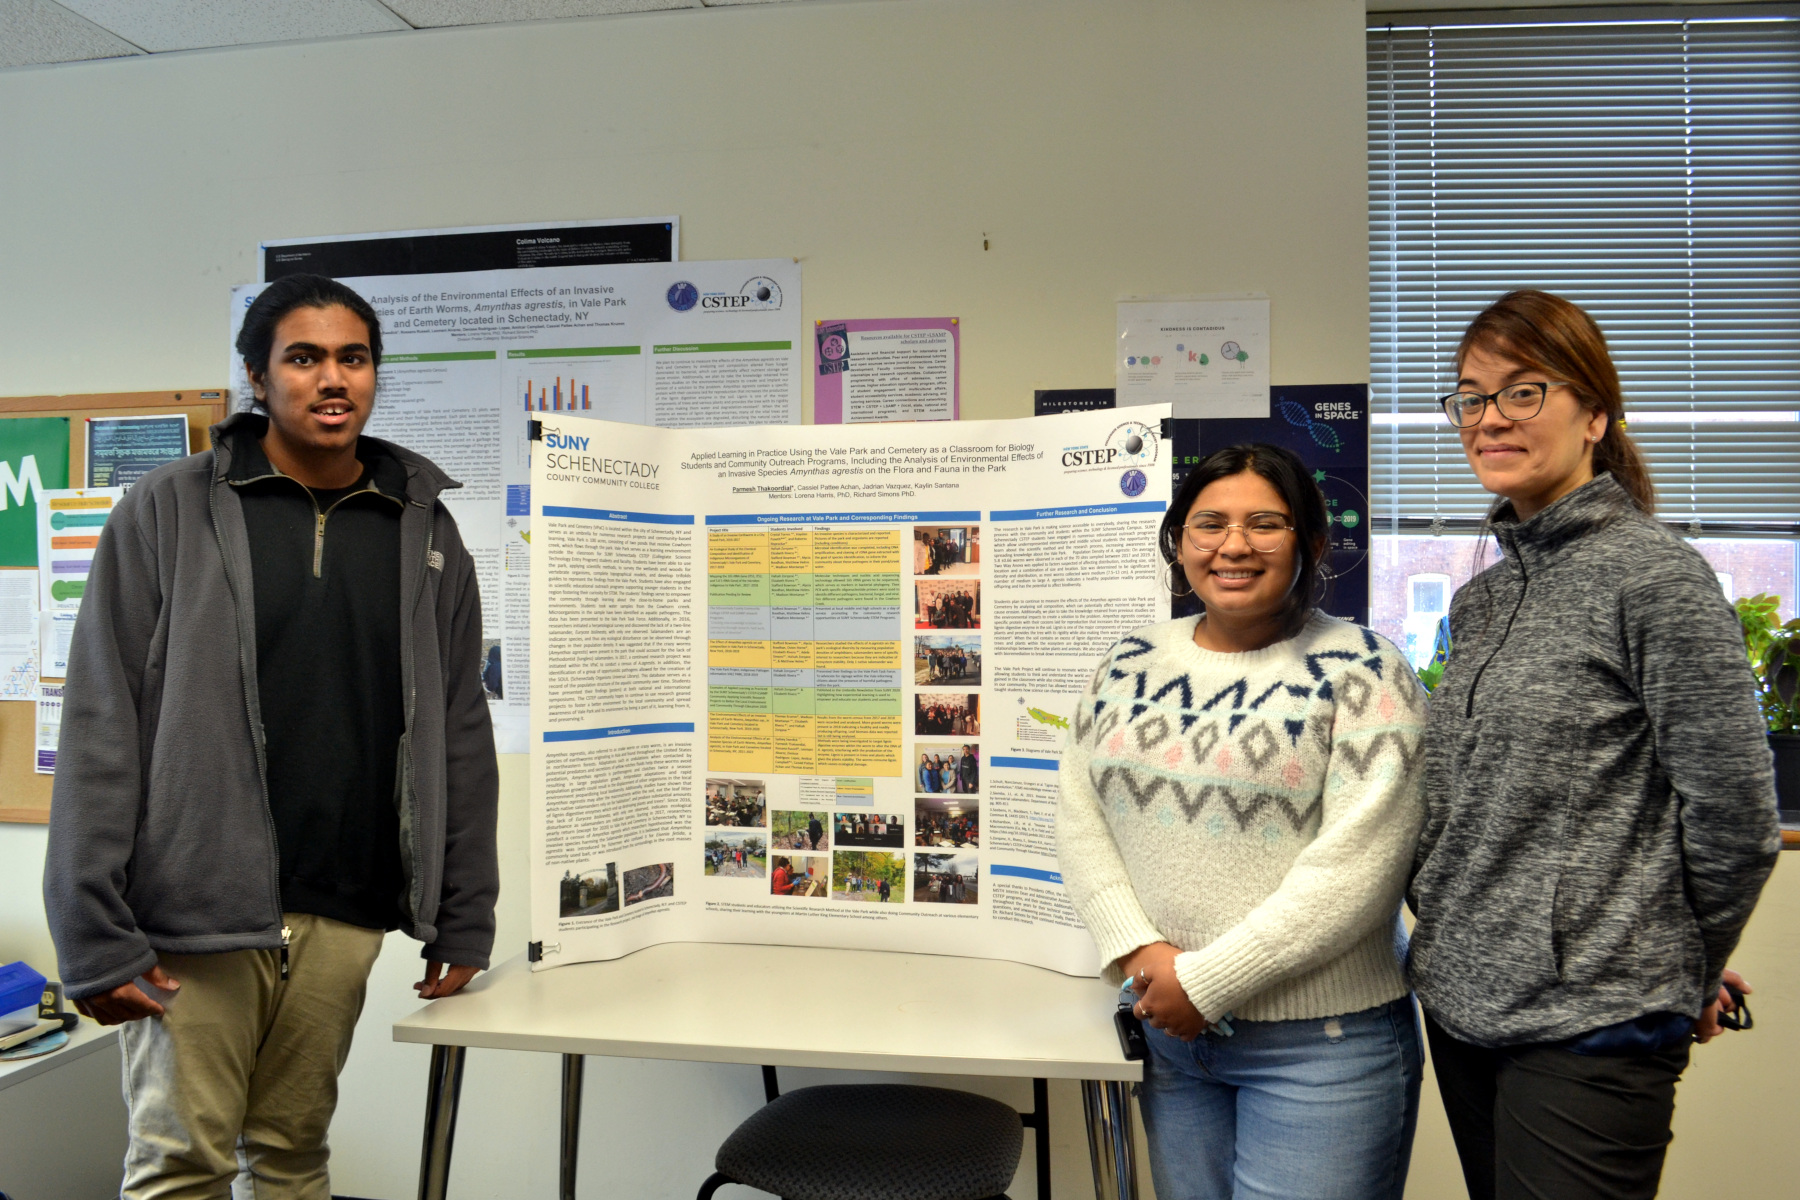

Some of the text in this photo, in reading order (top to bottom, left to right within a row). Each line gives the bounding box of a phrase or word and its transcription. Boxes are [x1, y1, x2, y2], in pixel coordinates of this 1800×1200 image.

[370, 294, 409, 307] Analysis
[412, 293, 421, 303] of
[423, 293, 438, 302] the
[441, 290, 508, 302] Environmental
[510, 289, 544, 299] Effects
[547, 288, 557, 297] of
[574, 286, 614, 296] Invasive
[398, 305, 407, 314] of
[409, 304, 433, 314] Earth
[436, 303, 472, 314] Worms,
[474, 301, 522, 314] Amynthas
[524, 299, 566, 312] agrestis,
[568, 298, 578, 308] in
[581, 297, 601, 307] Vale
[604, 296, 626, 306] Park
[702, 296, 750, 308] CSTEP
[394, 318, 411, 328] and
[413, 316, 457, 330] Cemetery
[459, 315, 494, 325] located
[496, 314, 506, 324] in
[508, 311, 572, 326] Schenectady,
[575, 311, 589, 321] NY
[1315, 402, 1351, 411] GENES
[1324, 411, 1359, 419] SPACE
[546, 434, 589, 451] SUNY
[691, 452, 716, 461] Applied
[718, 450, 747, 460] Learning
[790, 448, 813, 458] Using
[888, 446, 927, 456] Cemetery
[949, 445, 994, 453] Classroom
[1008, 443, 1034, 453] Biology
[1062, 448, 1117, 467] CSTEP
[546, 453, 659, 478] SCHENECTADY
[728, 459, 767, 470] Community
[807, 457, 847, 467] Programs,
[851, 457, 887, 466] Including
[904, 456, 938, 465] Analysis
[950, 454, 1009, 462] Environmental
[1011, 452, 1035, 461] Effects
[758, 468, 788, 478] Species
[790, 467, 830, 477] Amynthas
[832, 467, 864, 476] agrestis
[546, 474, 659, 490] COUNTY COMMUNITY COLLEGE
[757, 516, 779, 524] Ongoing
[850, 514, 893, 522] Corresponding
